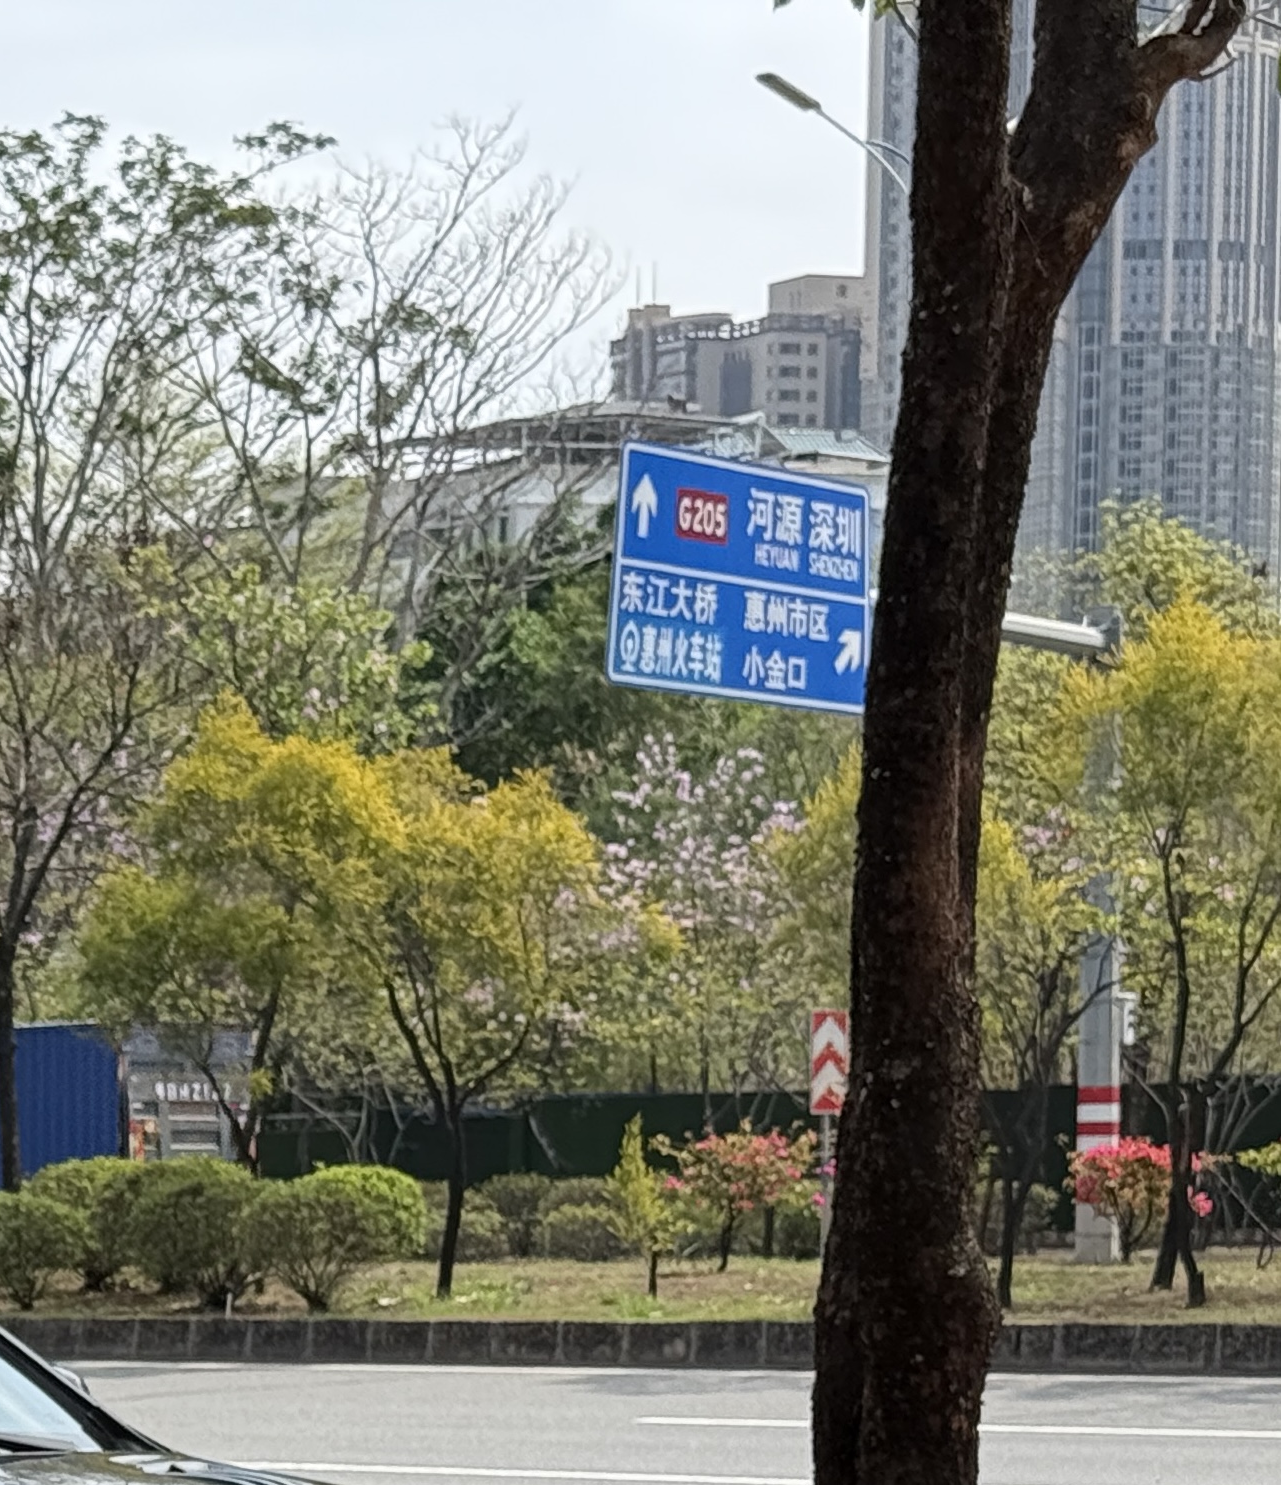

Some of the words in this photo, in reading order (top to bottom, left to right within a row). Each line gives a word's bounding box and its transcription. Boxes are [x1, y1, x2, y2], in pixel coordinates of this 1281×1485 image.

[677, 496, 728, 538] G205
[747, 487, 805, 546] 河源
[808, 500, 862, 560] 深圳
[620, 571, 718, 626] 东江大桥
[743, 590, 830, 643] 惠州市区
[639, 623, 723, 684] 惠州火车站
[742, 645, 807, 691] 小金口
